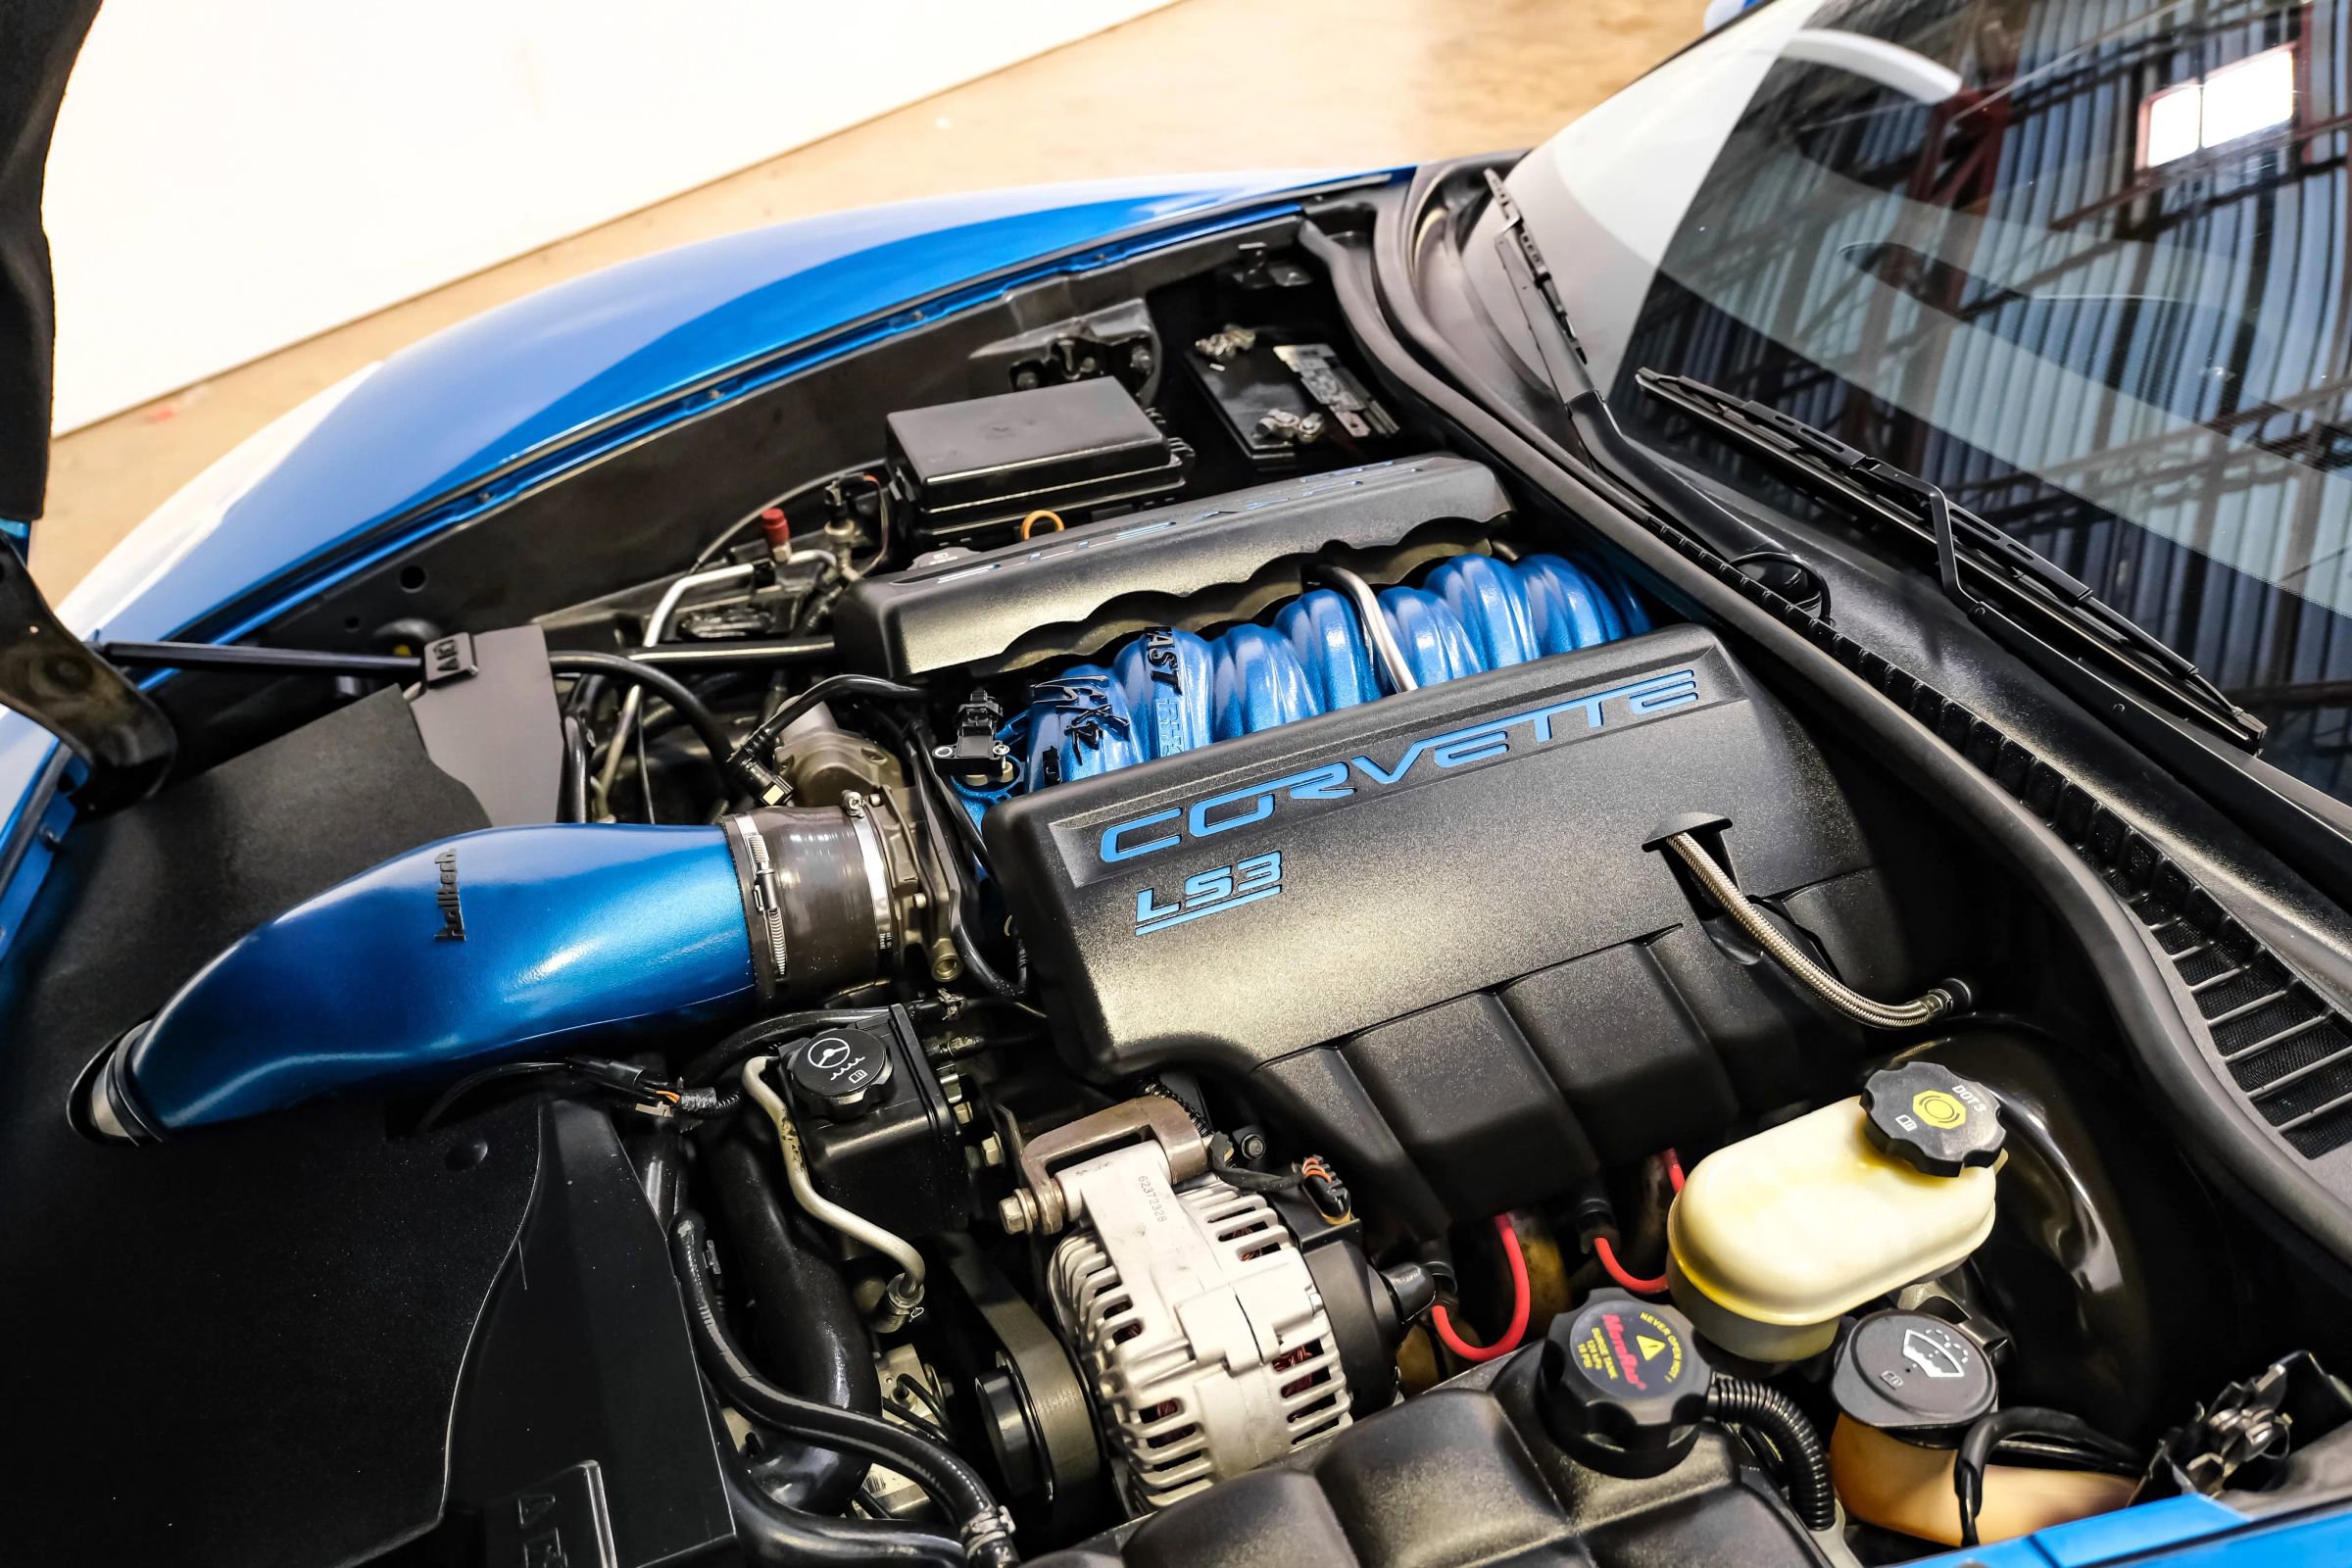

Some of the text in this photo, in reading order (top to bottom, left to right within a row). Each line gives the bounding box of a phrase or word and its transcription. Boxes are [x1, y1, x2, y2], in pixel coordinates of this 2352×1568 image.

[1100, 668, 1697, 863] CORVETTE
[1135, 850, 1283, 923] LS3
[1952, 1085, 1981, 1104] DOT
[1640, 1311, 1671, 1336] NEVER
